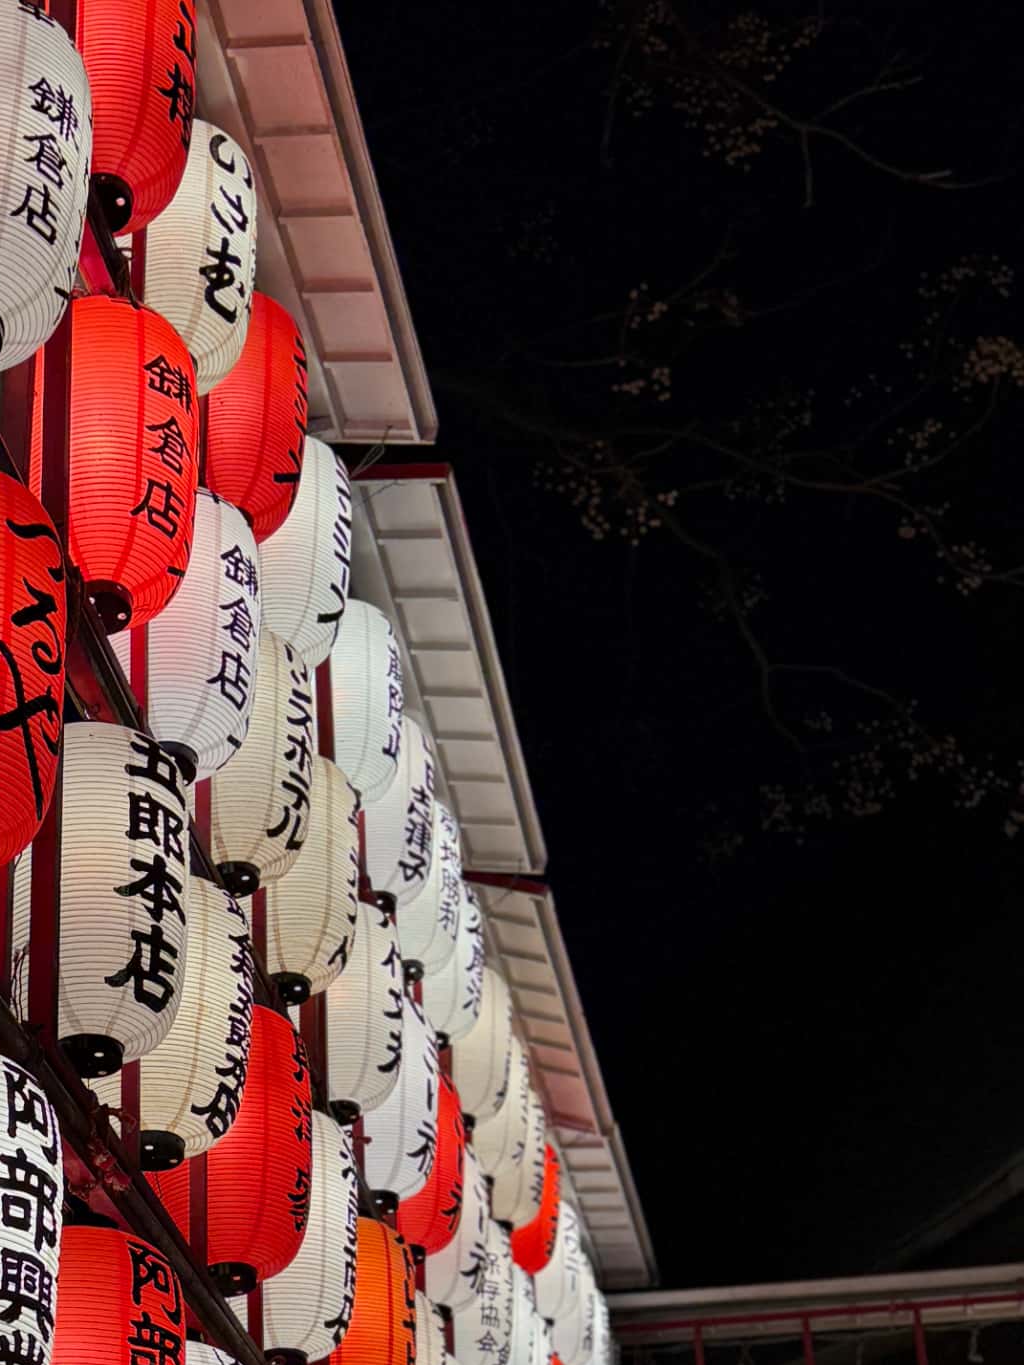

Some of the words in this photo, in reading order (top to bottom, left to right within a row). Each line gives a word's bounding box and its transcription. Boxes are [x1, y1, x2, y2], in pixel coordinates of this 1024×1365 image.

[10, 77, 78, 246] 鎌倉店
[131, 354, 194, 540] 鎌倉店
[207, 543, 259, 712] 鎌倉店
[104, 732, 187, 1014] 五郎本店
